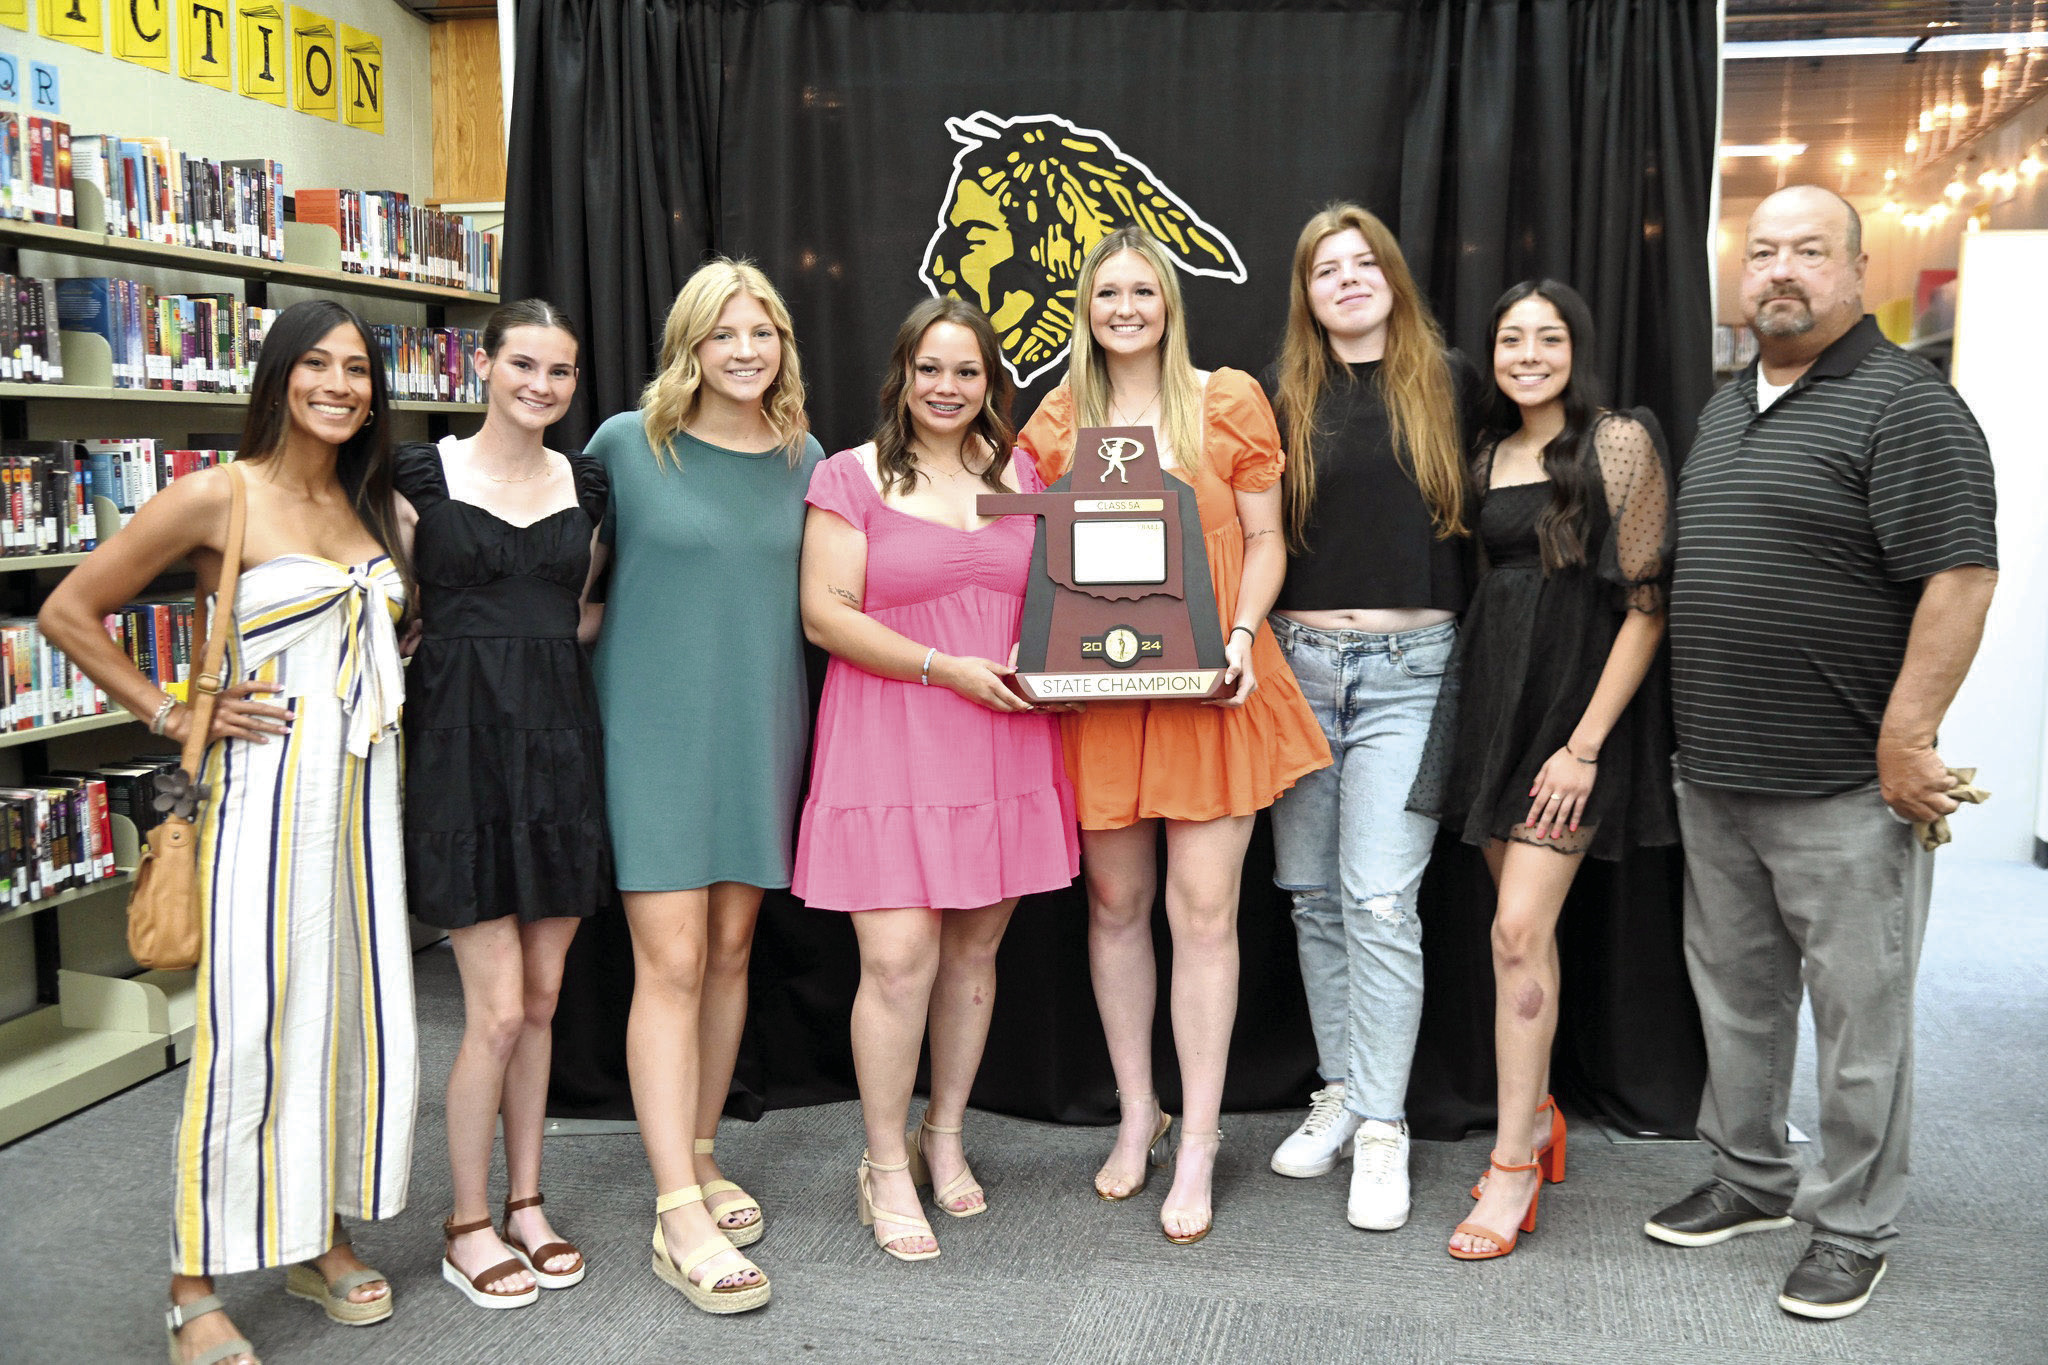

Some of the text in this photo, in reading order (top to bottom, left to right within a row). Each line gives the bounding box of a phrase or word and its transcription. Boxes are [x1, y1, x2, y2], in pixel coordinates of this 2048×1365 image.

[34, 67, 54, 105] R
[1097, 501, 1140, 510] CLASS 5A
[1082, 640, 1161, 652] 20 24
[1043, 676, 1201, 694] STATE CHAMPION
